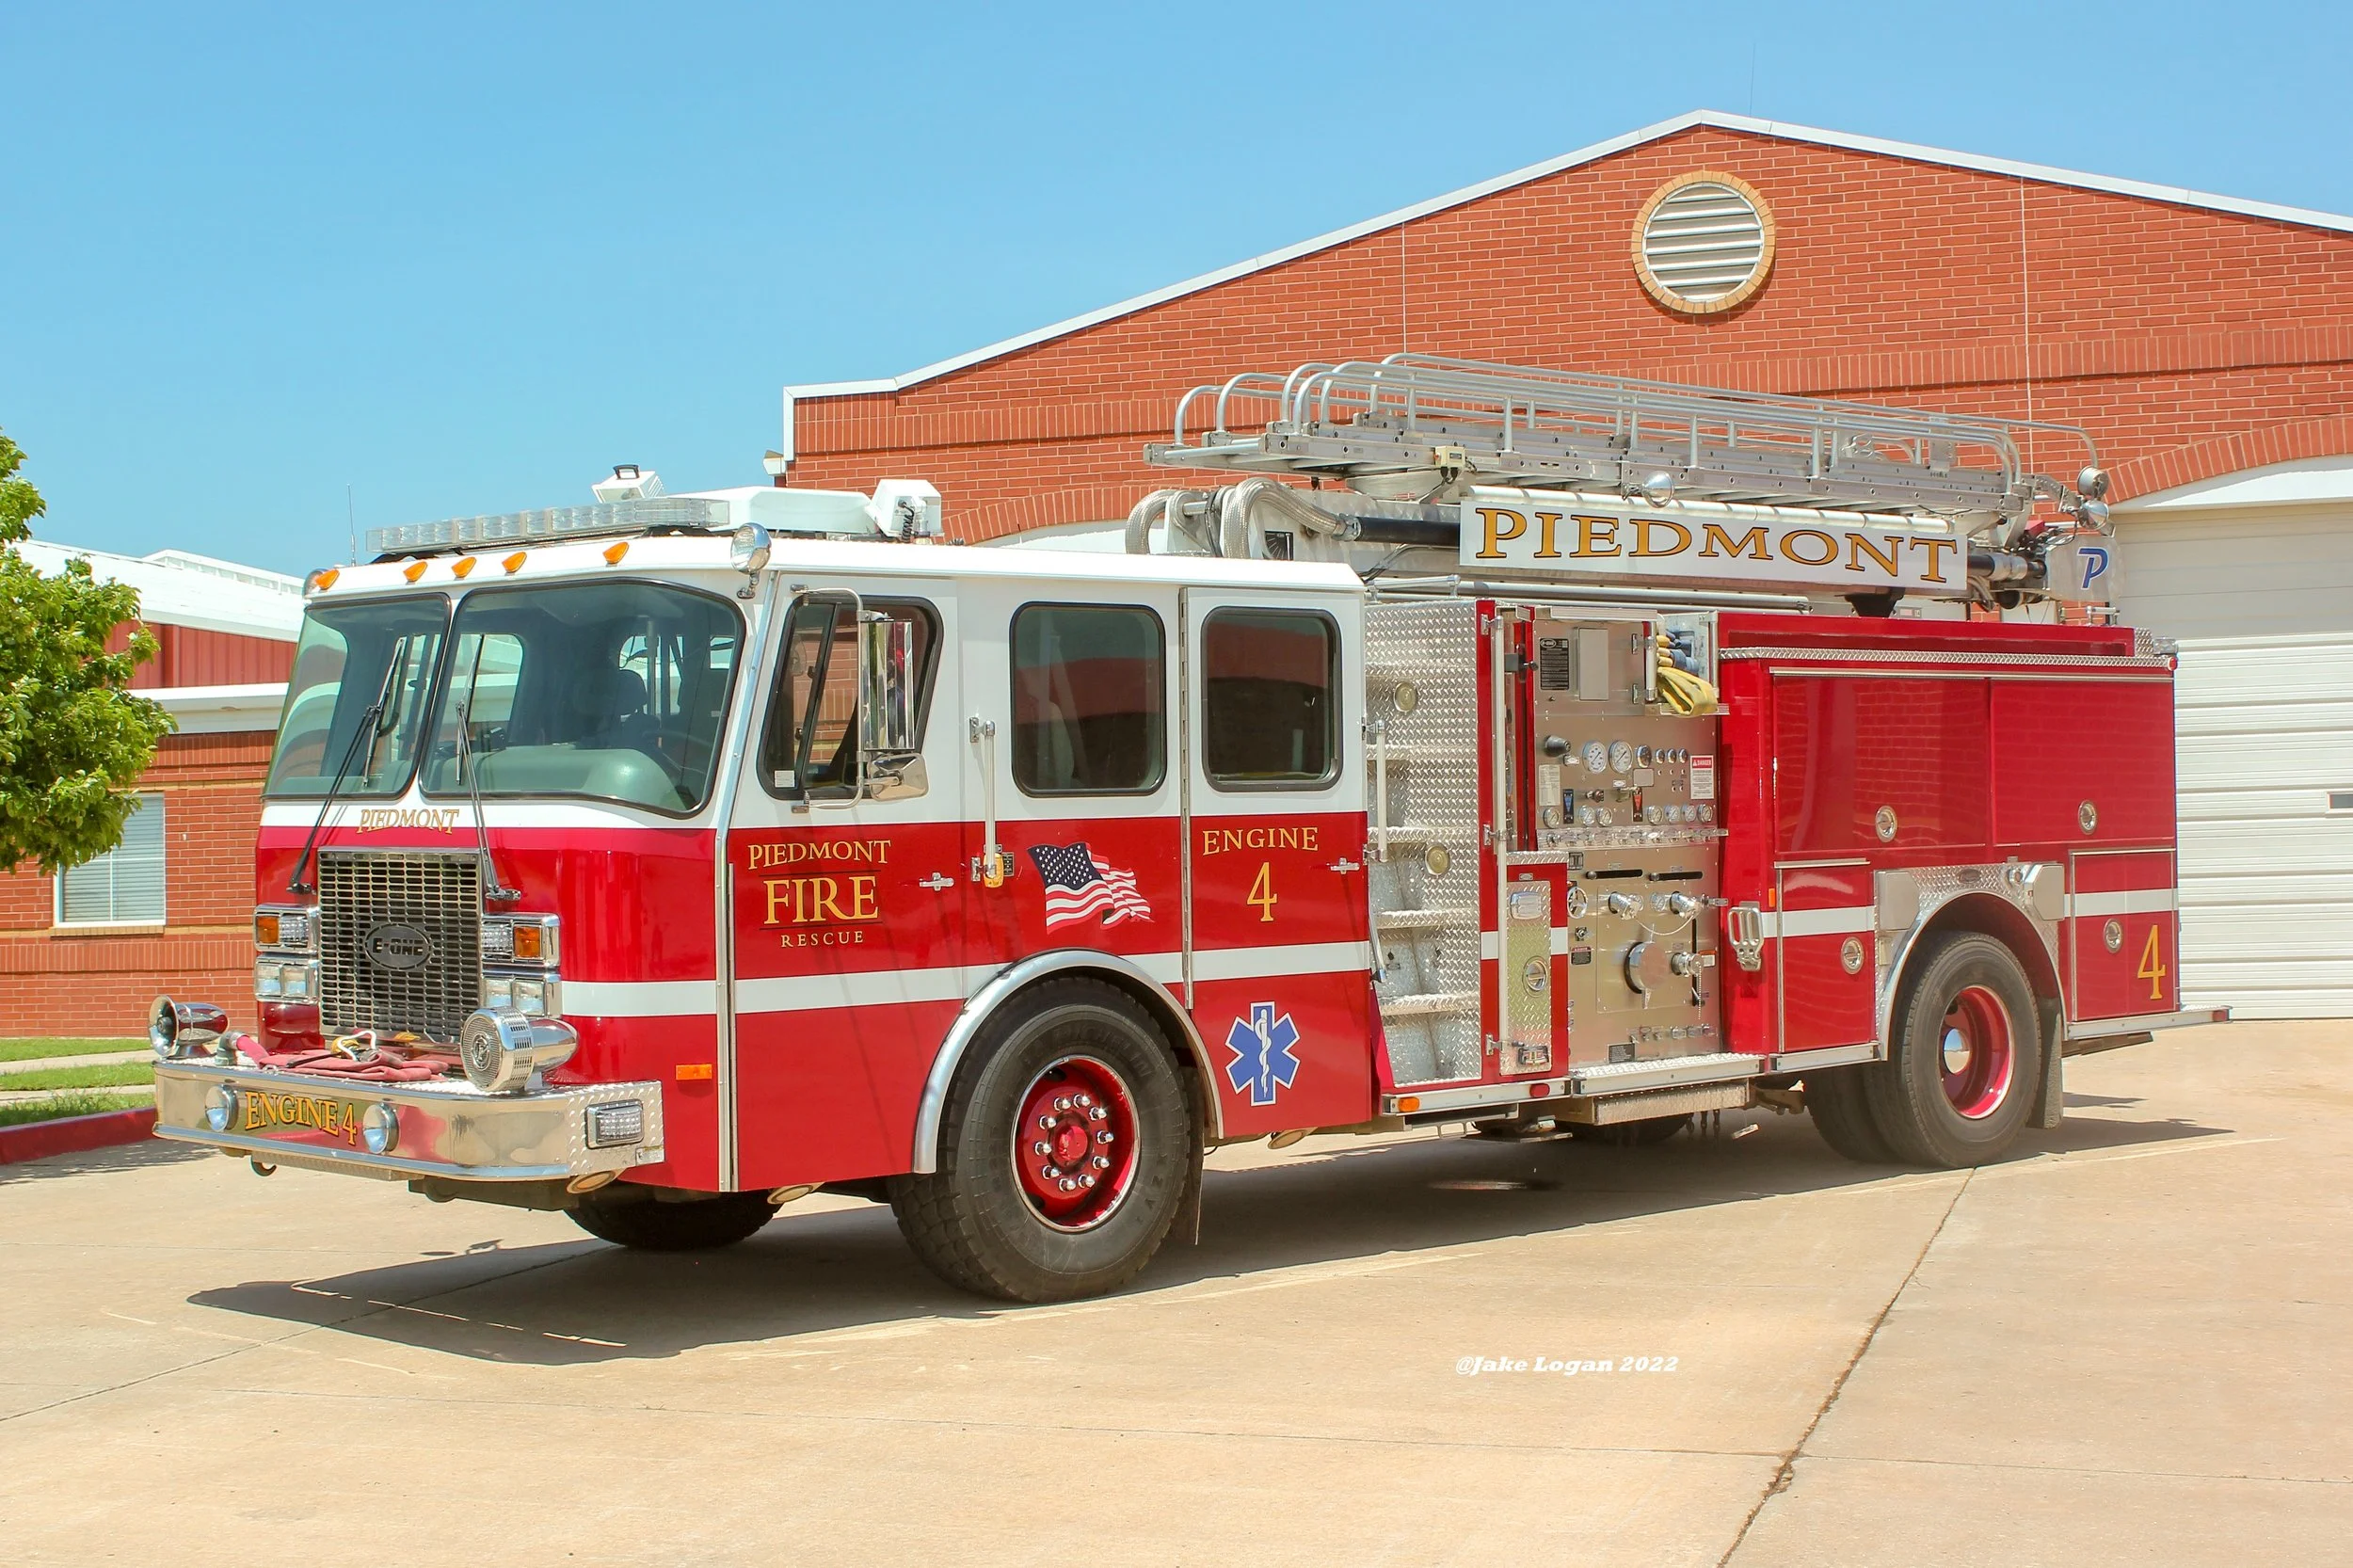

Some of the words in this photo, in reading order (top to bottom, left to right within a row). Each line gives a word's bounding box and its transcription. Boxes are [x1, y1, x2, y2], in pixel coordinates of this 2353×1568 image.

[1474, 507, 1959, 584] PIEDMONT
[2077, 547, 2109, 590] P
[356, 808, 460, 835] PIEDMONT
[1202, 826, 1319, 856] ENGINE
[747, 840, 891, 870] PIEDMONT
[763, 875, 879, 925] FIRE
[1246, 861, 1278, 921] 4
[373, 937, 424, 955] E-ONE
[780, 930, 864, 948] RESCUE
[2137, 924, 2167, 1000] 4
[245, 1091, 339, 1137] ENGINE
[342, 1103, 357, 1145] 4
